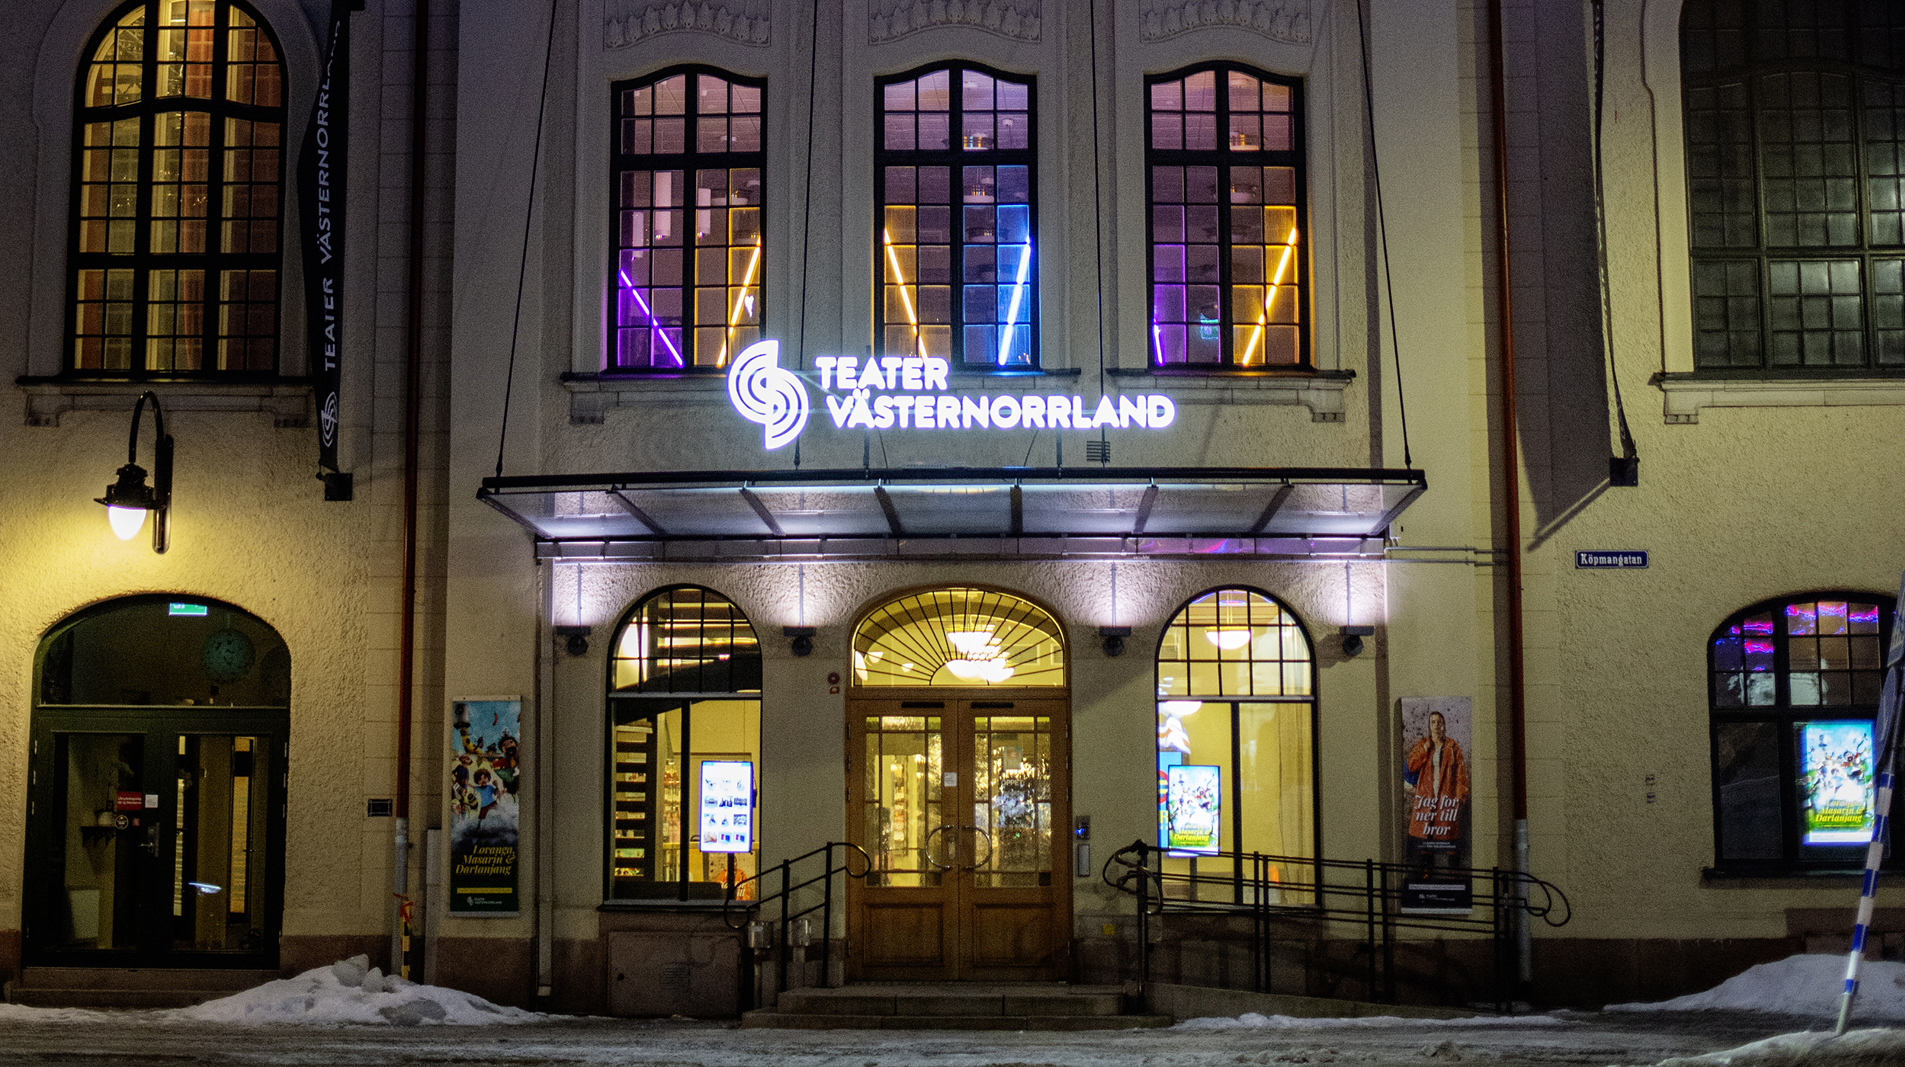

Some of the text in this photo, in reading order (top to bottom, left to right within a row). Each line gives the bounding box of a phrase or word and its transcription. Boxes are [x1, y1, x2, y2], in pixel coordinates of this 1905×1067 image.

[316, 20, 340, 265] VÄSTERNORRL
[814, 356, 949, 391] TEATER
[825, 389, 1177, 430] VÄSTERNORRLAND
[1580, 553, 1642, 566] Köpmangatan
[1414, 795, 1459, 810] Jag for
[1416, 808, 1458, 822] ner till
[1815, 814, 1862, 823] Dartanjang
[1422, 823, 1451, 836] bror
[472, 845, 515, 857] Loranga,
[462, 854, 516, 864] Masarin &
[455, 864, 512, 876] Dartanjang
